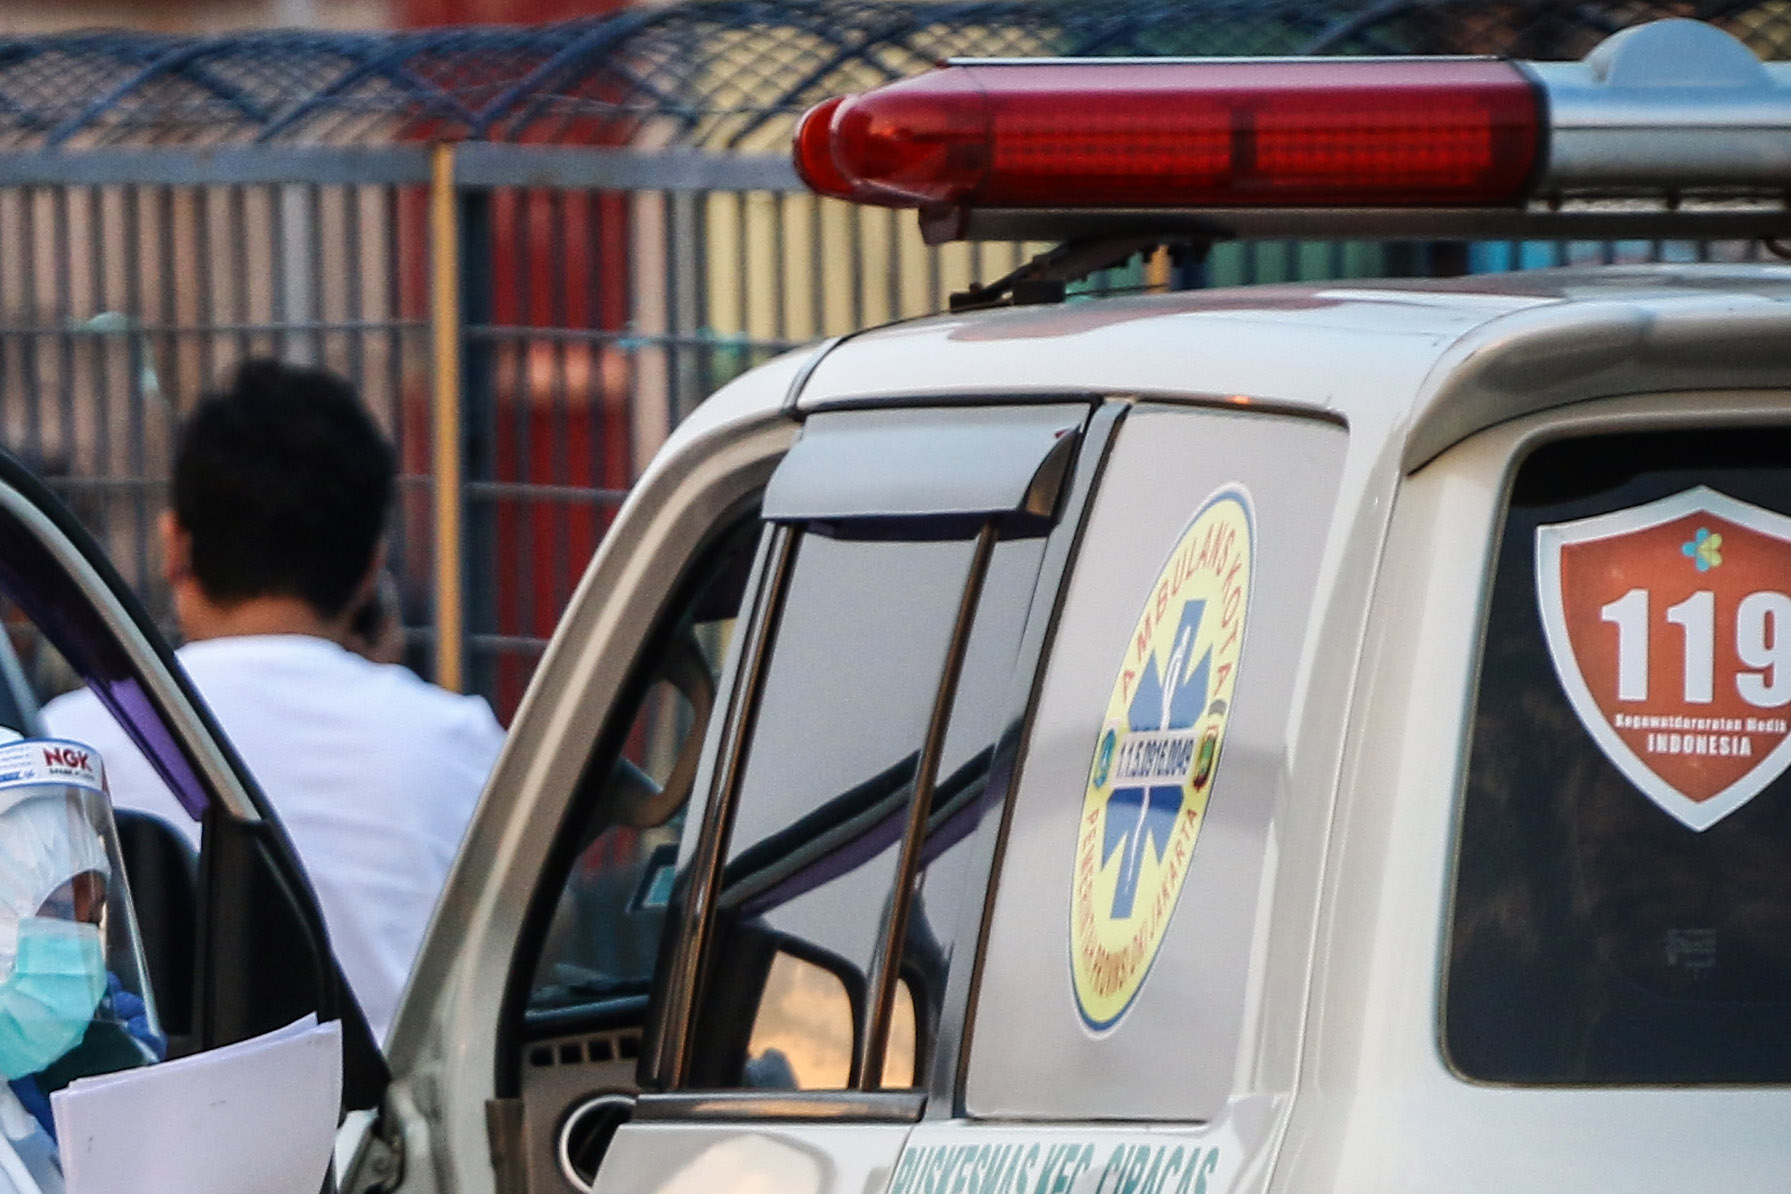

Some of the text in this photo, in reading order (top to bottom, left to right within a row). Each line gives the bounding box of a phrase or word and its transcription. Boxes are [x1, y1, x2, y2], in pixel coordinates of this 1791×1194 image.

[1123, 520, 1243, 703] AMBULANS KOTA
[1600, 587, 1791, 709] 119
[42, 746, 94, 773] NGK
[1647, 731, 1753, 757] INDONESIA
